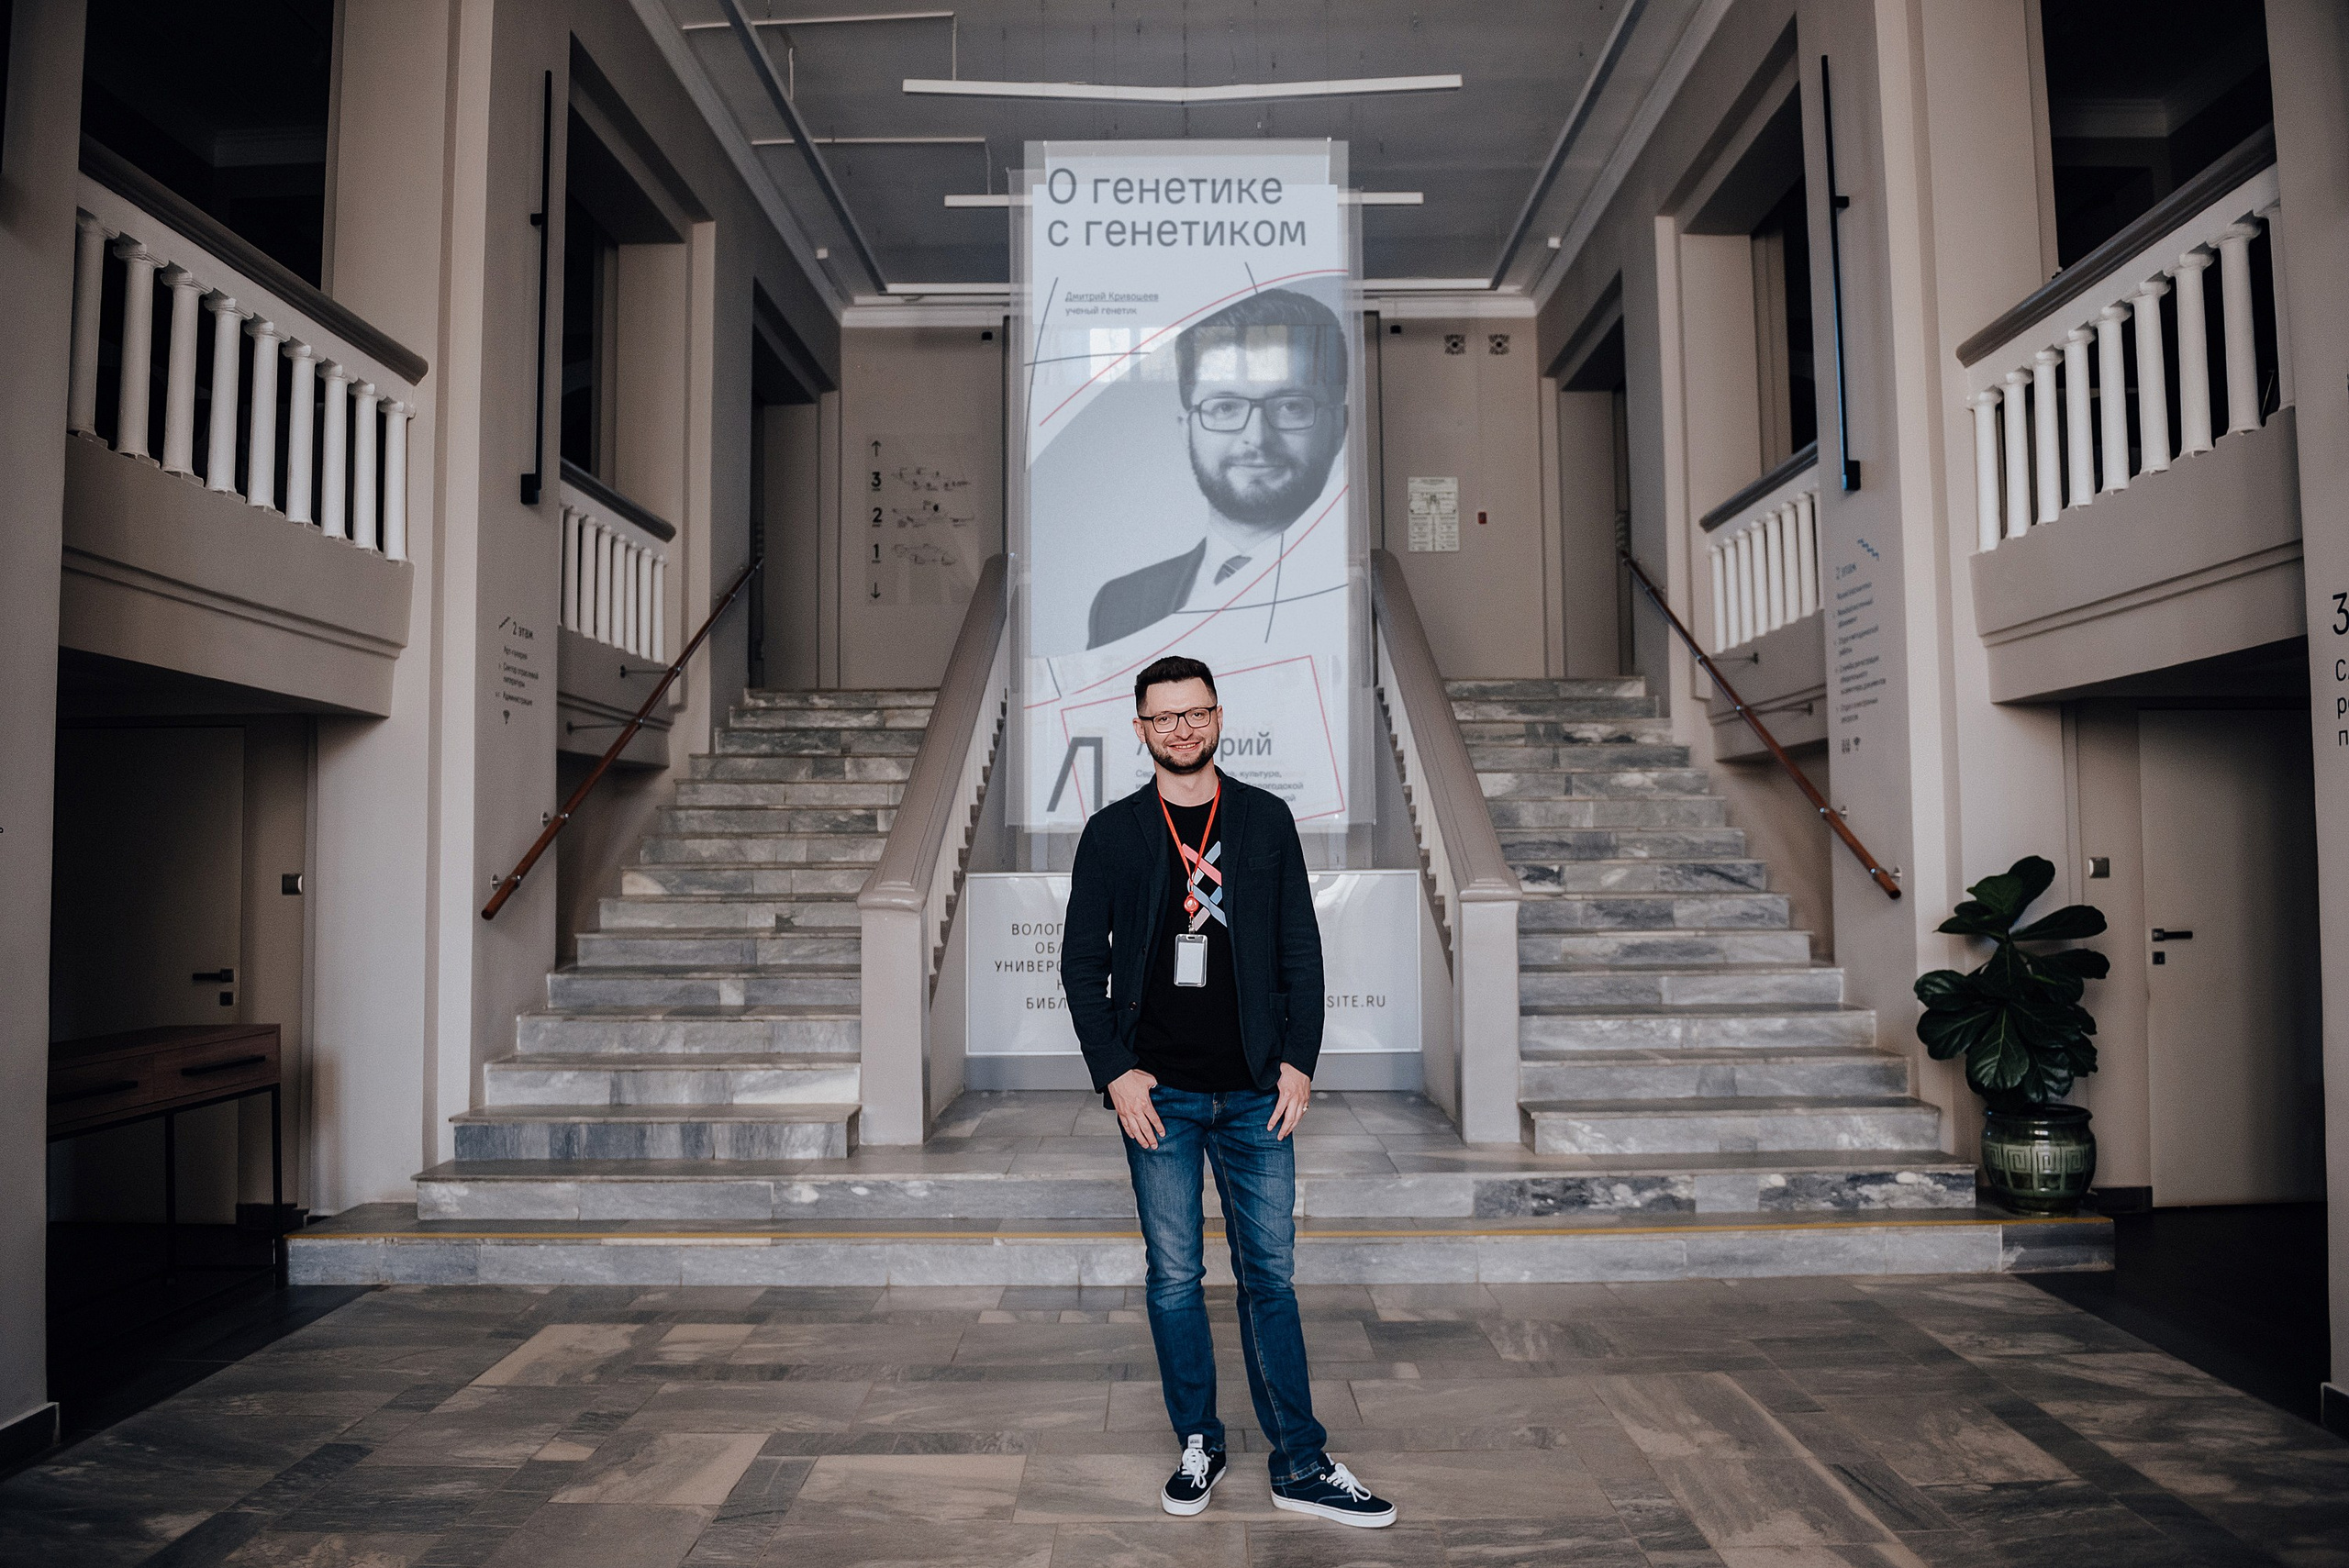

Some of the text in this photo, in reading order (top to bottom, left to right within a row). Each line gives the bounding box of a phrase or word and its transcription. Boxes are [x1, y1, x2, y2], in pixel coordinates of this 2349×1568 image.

[1047, 167, 1283, 205] О генетике
[1047, 219, 1307, 247] с генетиком
[1064, 291, 1107, 302] Дмитрий
[1101, 307, 1137, 316] генетик
[872, 471, 882, 487] 3
[872, 506, 883, 523] 2
[873, 543, 880, 559] 1
[1220, 731, 1272, 762] рий
[1011, 923, 1063, 936] ВОЛОГ
[1026, 997, 1066, 1009] БИБЛ
[1327, 995, 1386, 1008] SITE.RU
